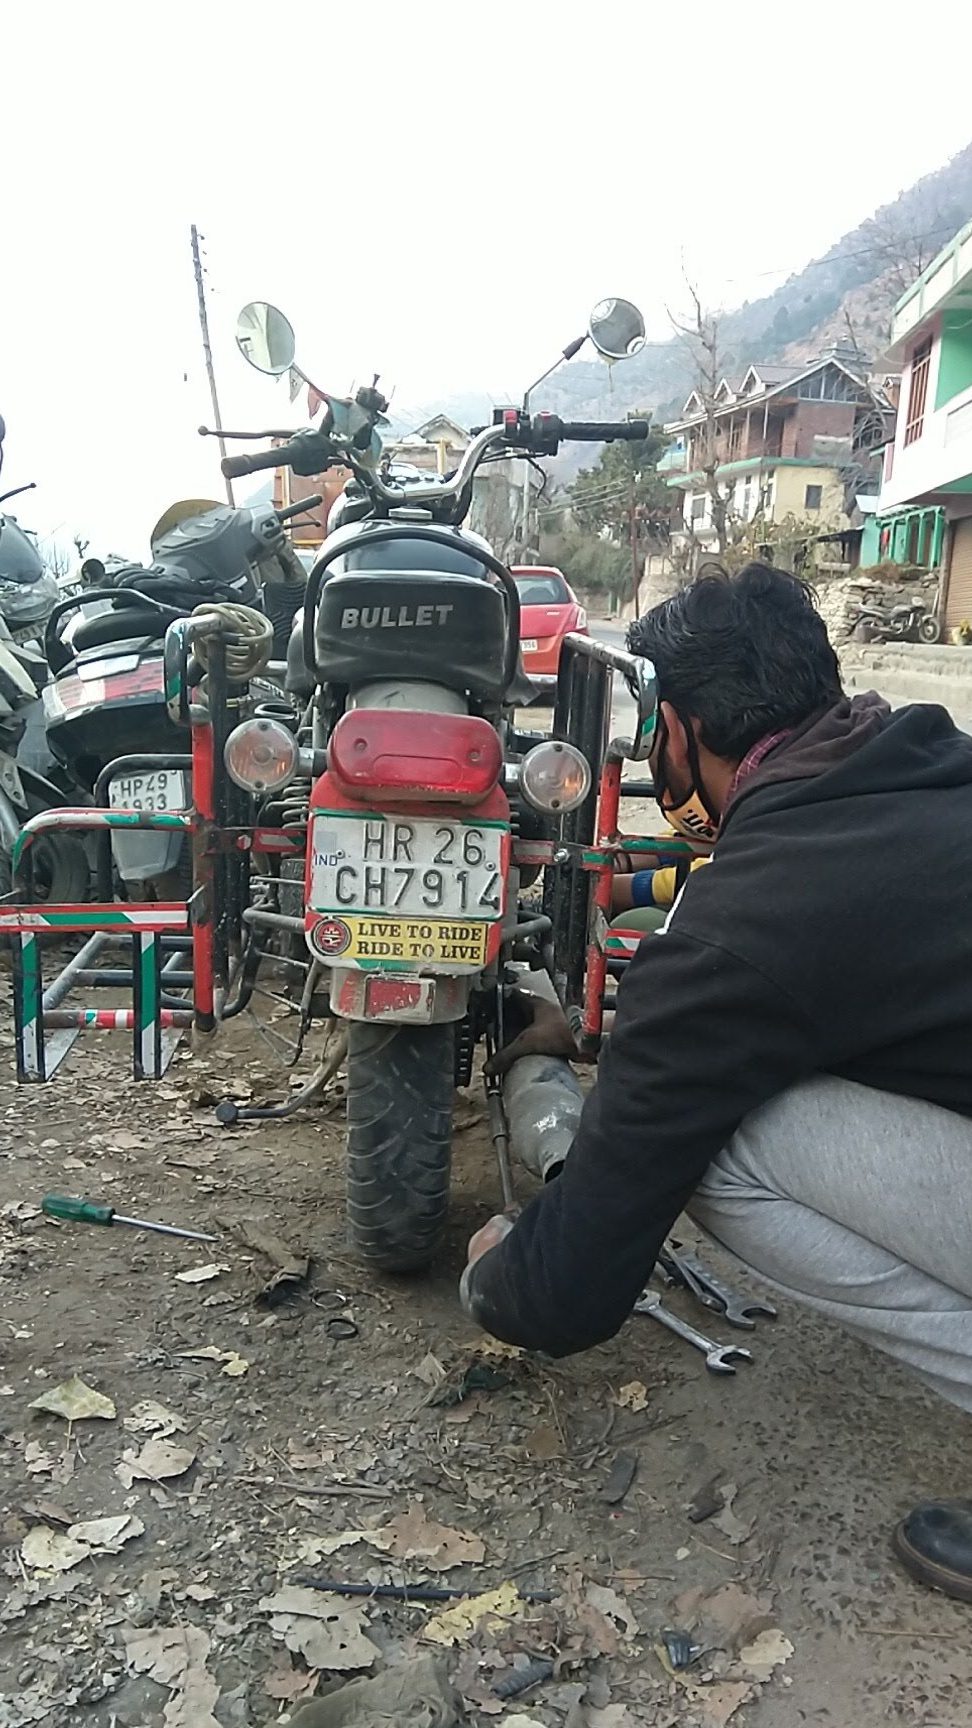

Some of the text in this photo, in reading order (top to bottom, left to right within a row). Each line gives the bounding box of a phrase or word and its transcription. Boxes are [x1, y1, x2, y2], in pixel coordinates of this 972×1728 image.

[341, 604, 454, 629] BULLET
[363, 822, 484, 866] HR 26
[314, 854, 338, 867] IND
[335, 865, 500, 913] CH7914
[357, 922, 483, 941] LIVE TO RIDE
[356, 941, 481, 960] RIDE TO LIVE
